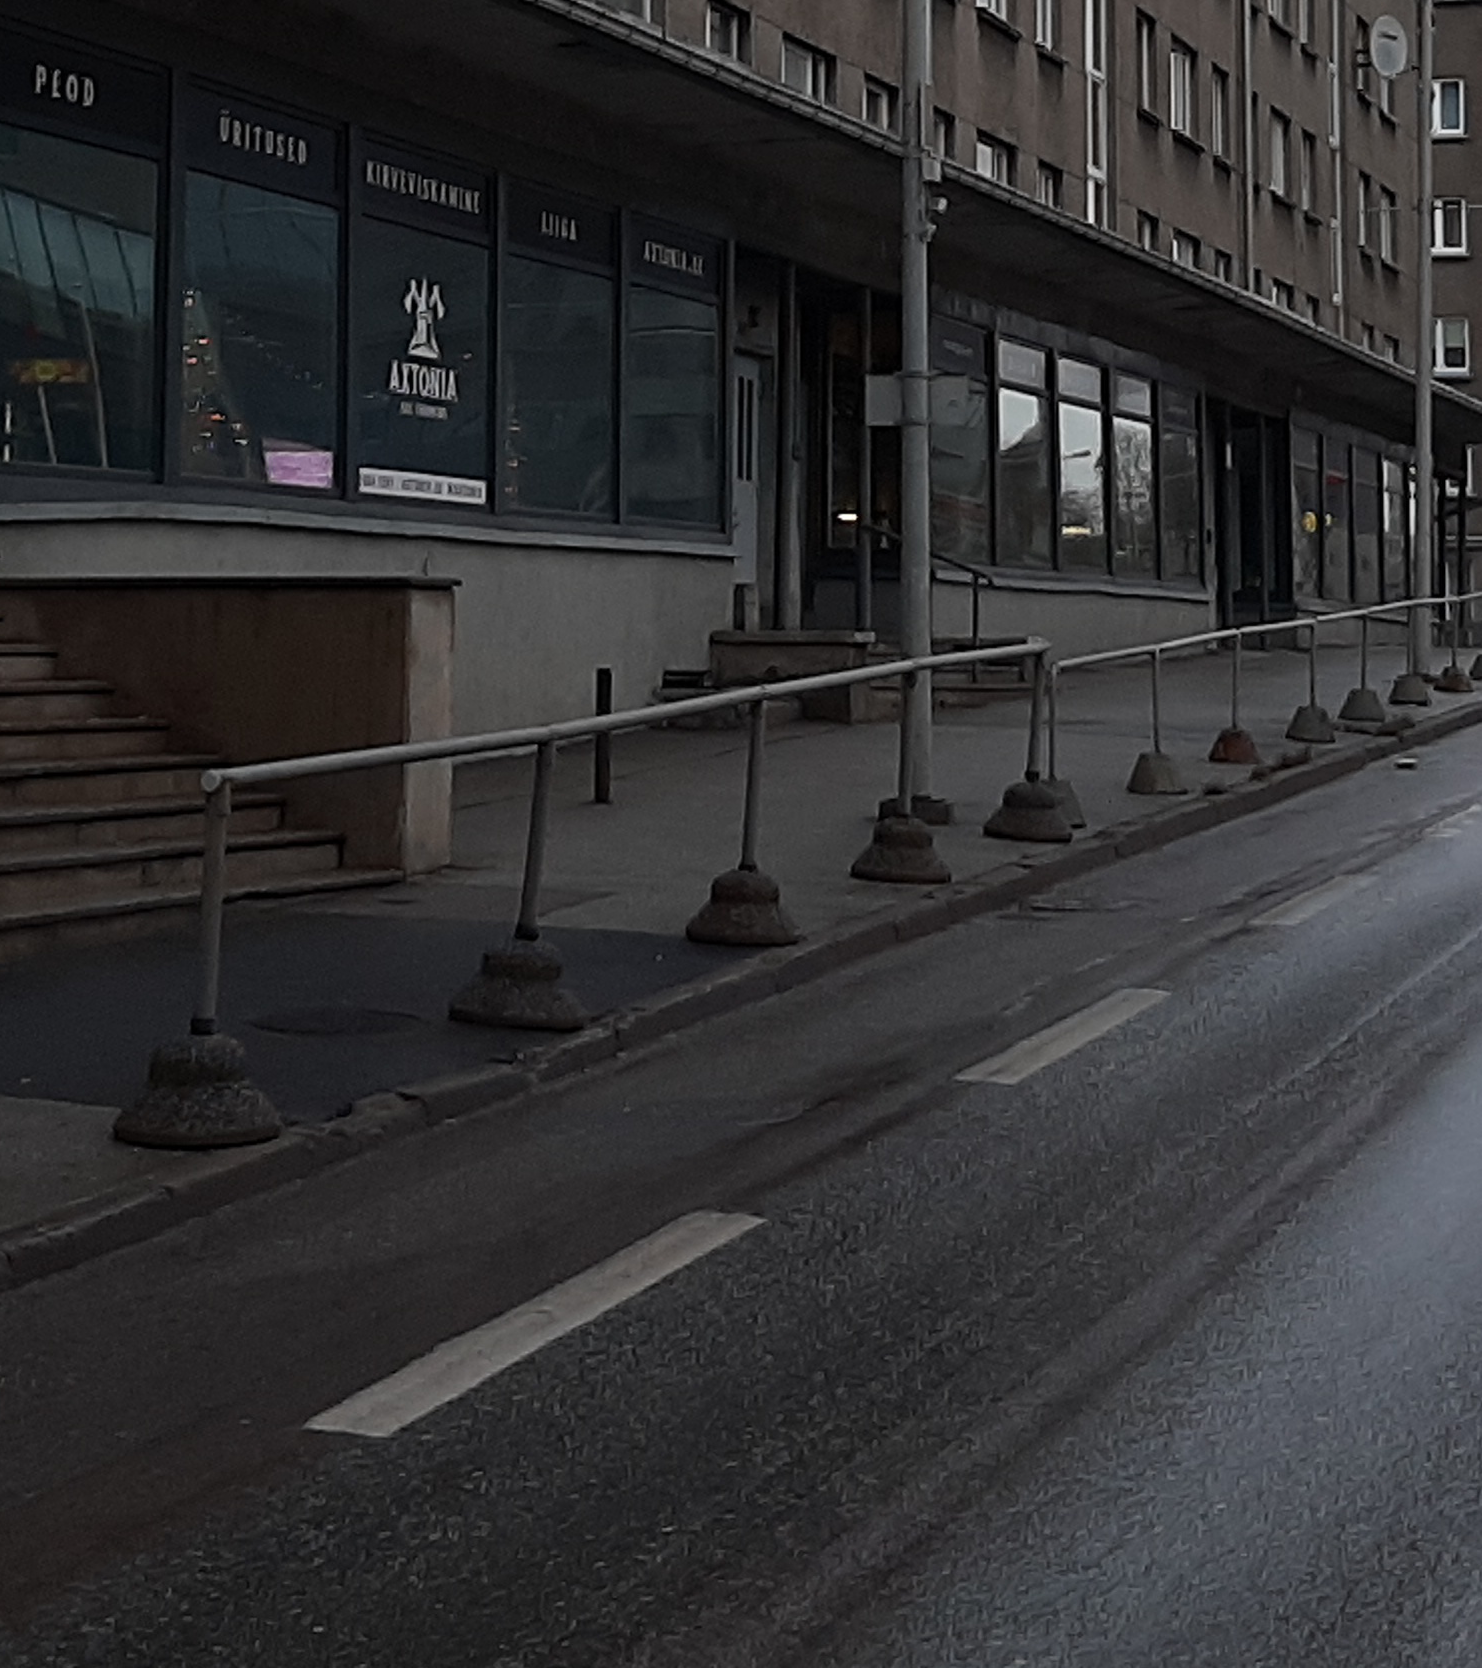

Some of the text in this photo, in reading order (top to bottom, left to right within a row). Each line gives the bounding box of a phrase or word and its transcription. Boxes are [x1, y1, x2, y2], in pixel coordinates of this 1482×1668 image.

[34, 64, 96, 108] PEOD
[218, 108, 308, 166] ÜRITUSED
[541, 210, 578, 242] LIIGA
[389, 359, 459, 403] AXTONIA
